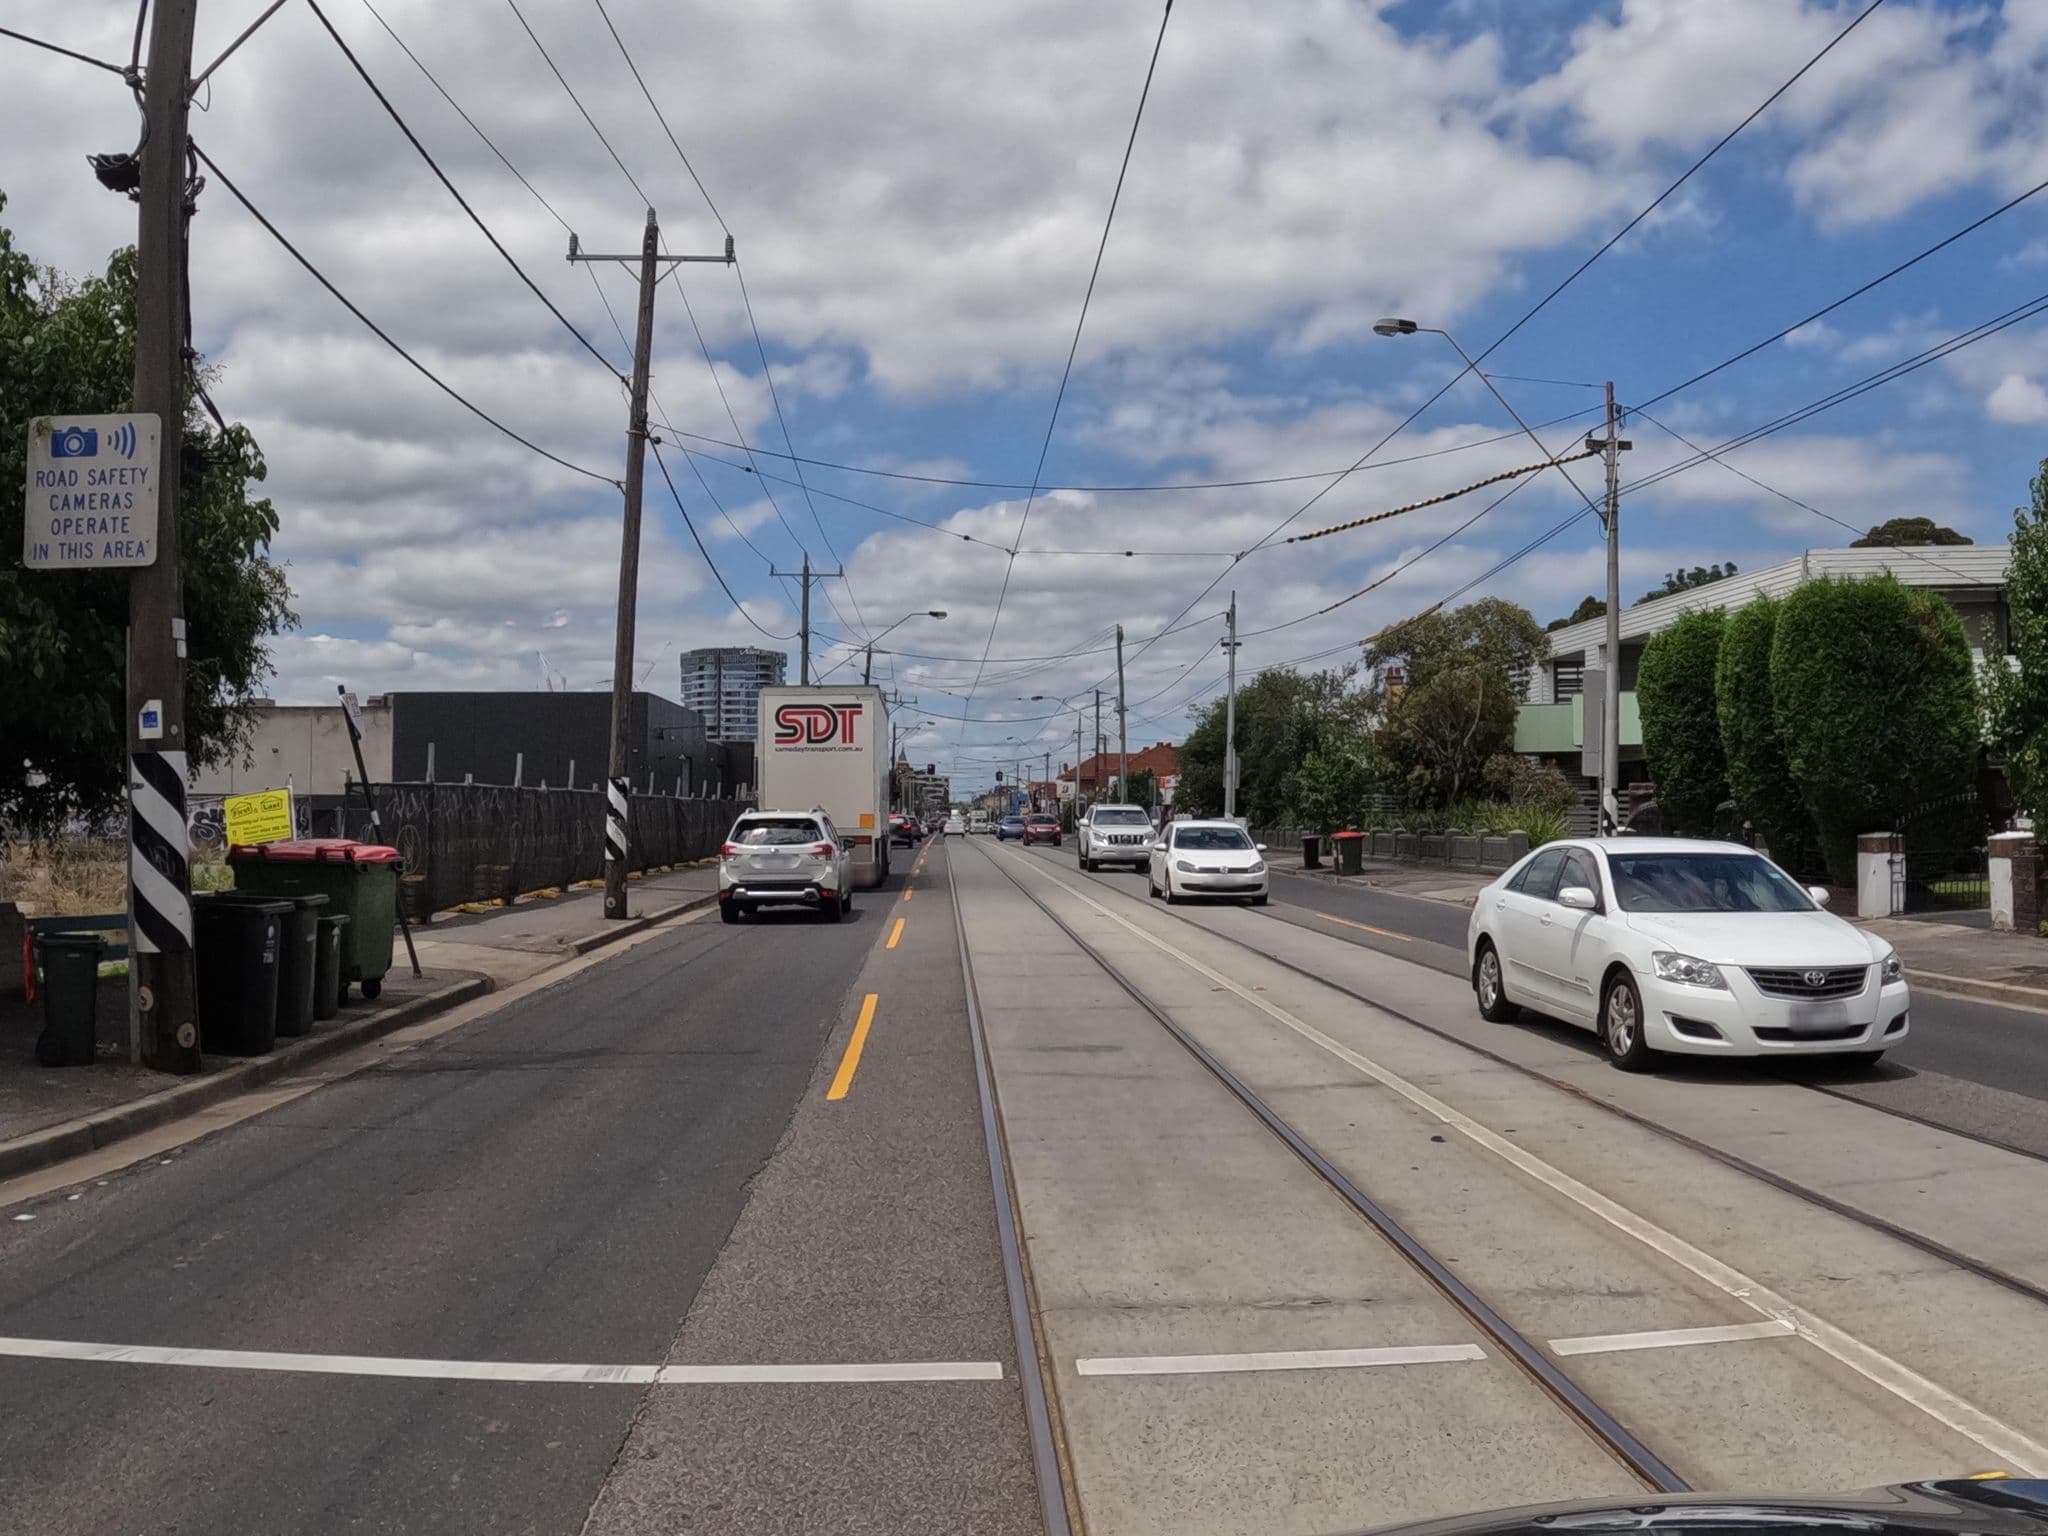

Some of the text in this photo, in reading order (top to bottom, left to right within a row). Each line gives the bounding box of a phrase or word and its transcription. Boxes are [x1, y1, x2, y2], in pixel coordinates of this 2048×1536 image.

[36, 467, 149, 488] ROAD SAFETY
[49, 492, 134, 511] CAMERAS
[51, 516, 131, 536] OPERATE
[33, 540, 146, 561] IN THIS AREA
[775, 703, 863, 744] SDT
